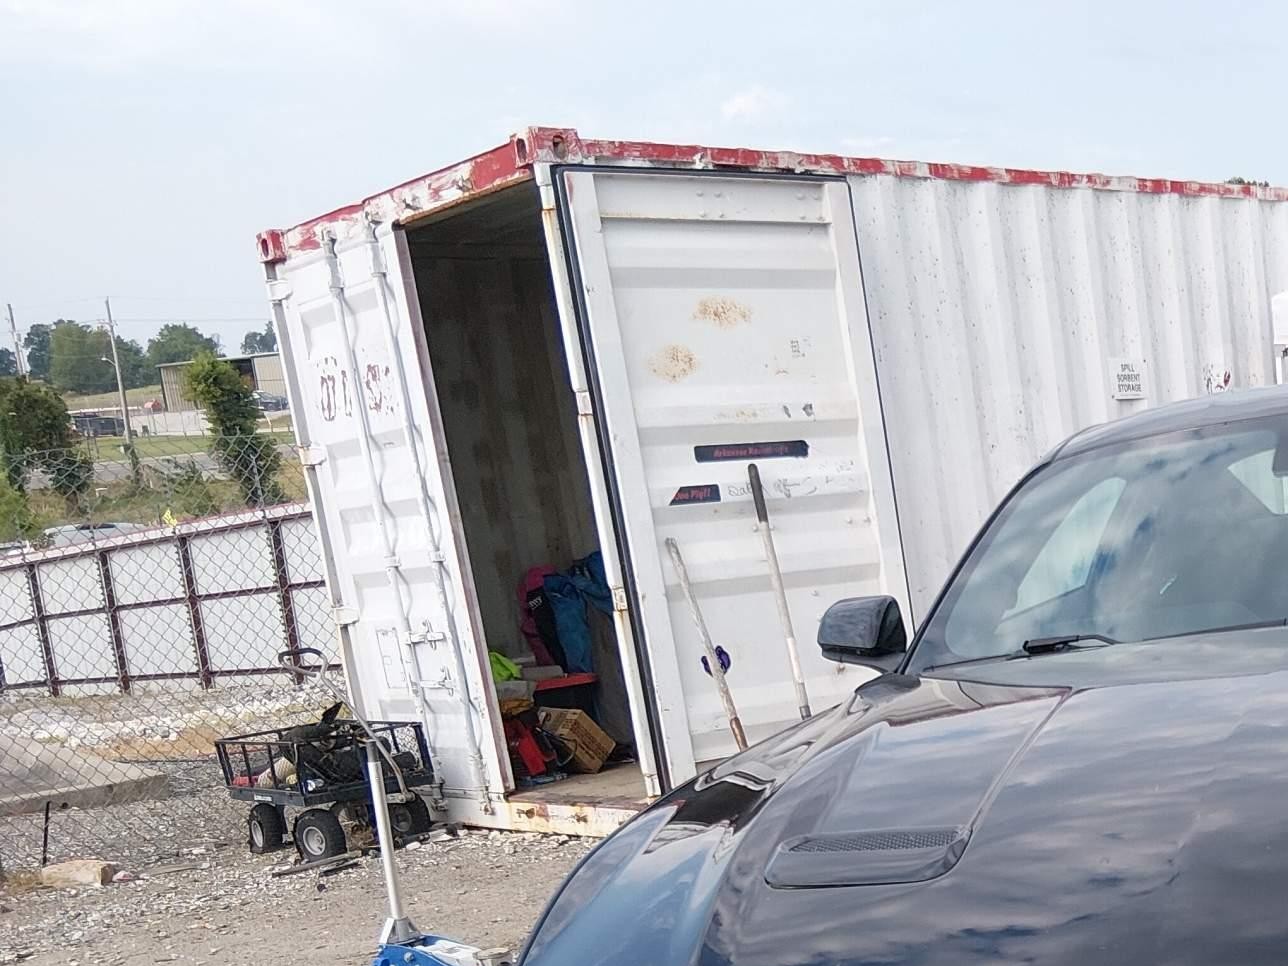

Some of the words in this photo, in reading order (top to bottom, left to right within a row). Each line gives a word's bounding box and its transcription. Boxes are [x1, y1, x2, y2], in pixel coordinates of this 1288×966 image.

[1121, 363, 1135, 372] SPILL
[1116, 373, 1140, 382] SORBENT
[1117, 383, 1142, 392] STORAGE
